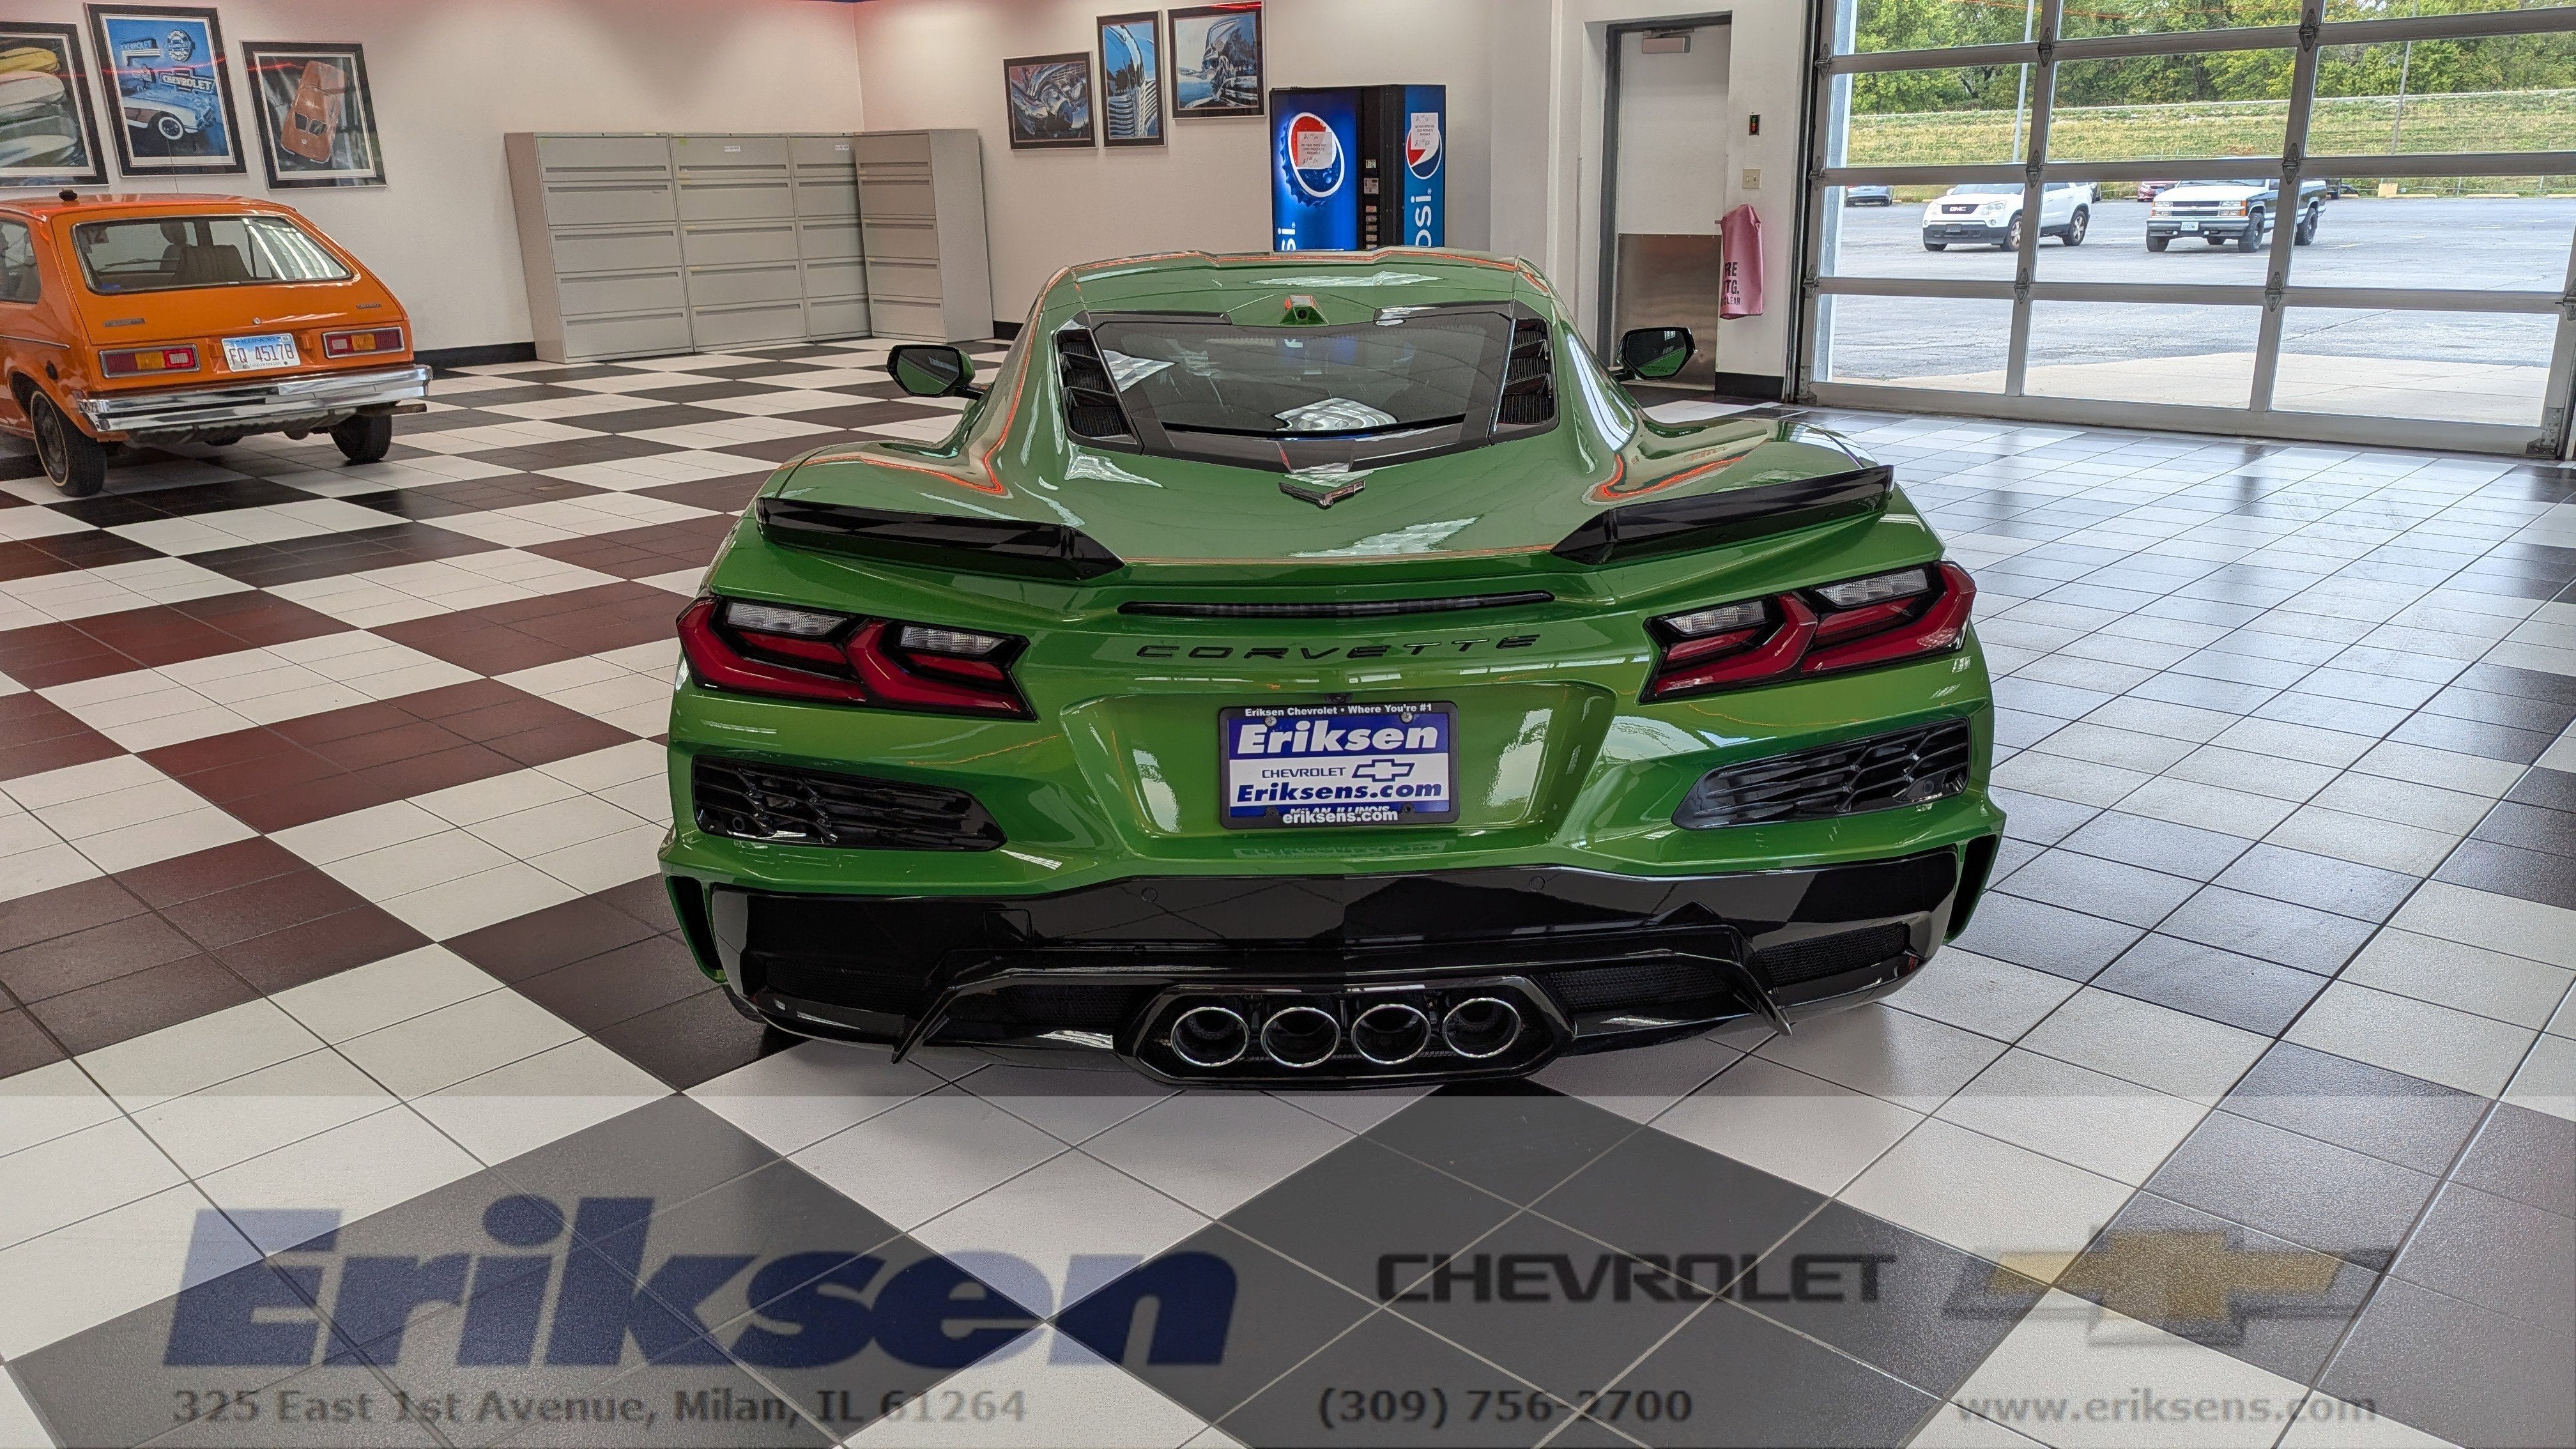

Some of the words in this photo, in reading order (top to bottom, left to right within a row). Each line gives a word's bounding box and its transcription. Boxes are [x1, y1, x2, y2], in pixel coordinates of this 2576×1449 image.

[1723, 279, 1740, 295] TG.
[229, 347, 248, 365] FQ
[255, 343, 295, 362] 45178
[1137, 634, 1541, 659] CORVETTE
[1245, 707, 1285, 717] Eriksen
[1286, 706, 1338, 716] Chevrolet
[1347, 705, 1382, 714] Where
[1383, 703, 1417, 712] You're
[1419, 703, 1432, 712] #1
[1237, 719, 1438, 755] Eriksen
[1262, 767, 1347, 778] CHEVROLET
[1236, 781, 1442, 803] Eriksens.com
[1282, 809, 1399, 824] eriksens.com
